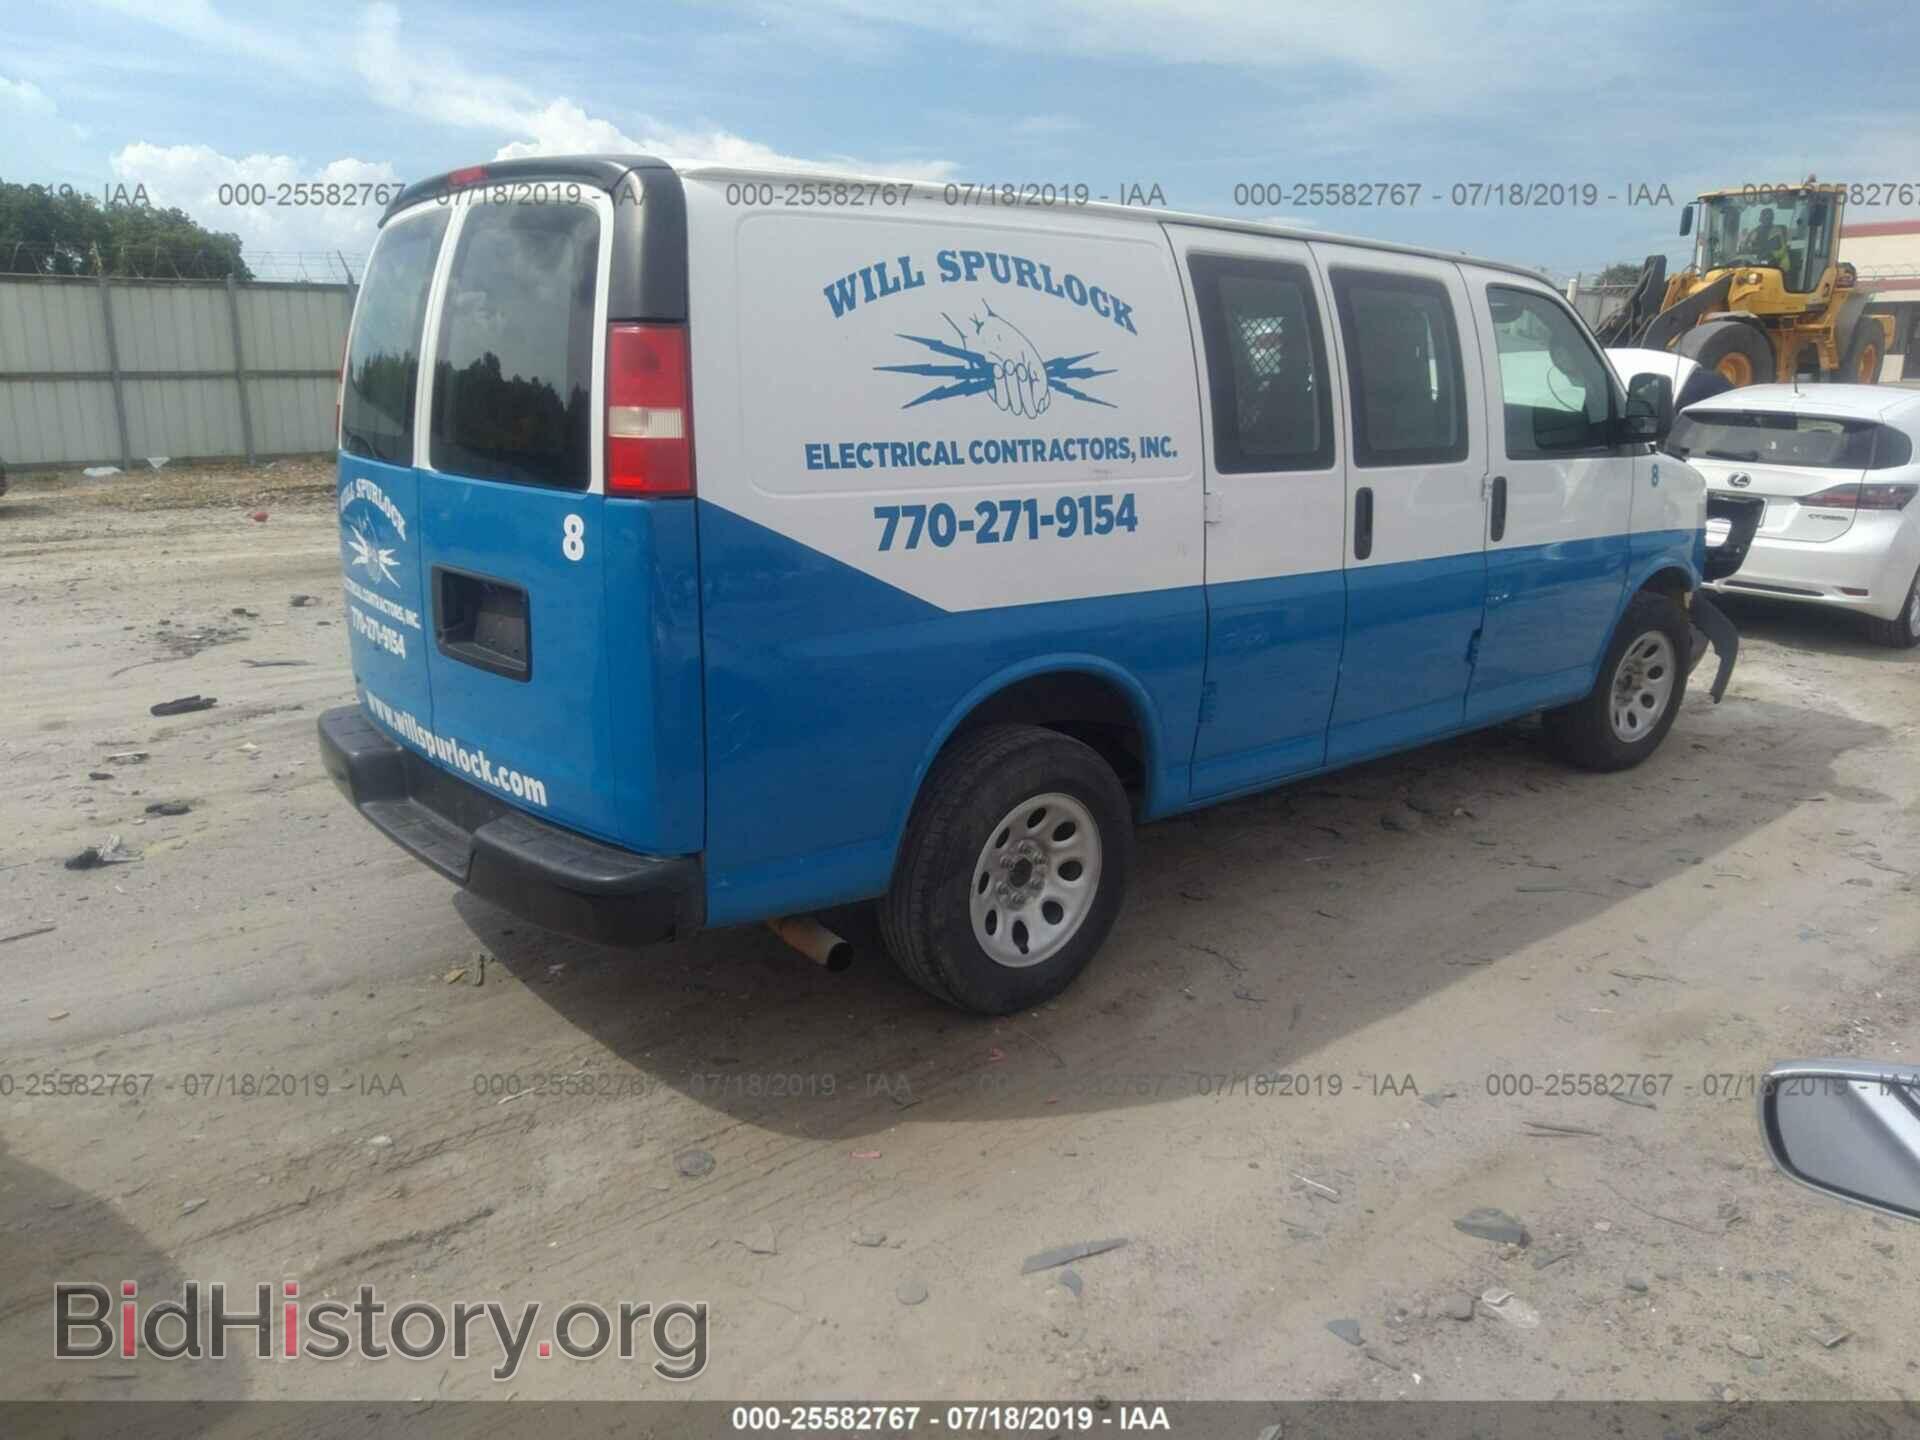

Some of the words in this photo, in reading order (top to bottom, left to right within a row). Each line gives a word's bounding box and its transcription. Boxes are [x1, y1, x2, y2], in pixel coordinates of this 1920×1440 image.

[823, 255, 926, 318] WILL
[936, 249, 1139, 336] SPURLOCK
[804, 440, 965, 471] ELECTRICAL
[968, 436, 1137, 466] CONTRACTORS,
[1140, 435, 1178, 459] INC.
[562, 513, 585, 562] 8
[872, 493, 1139, 552] 770-271-9154
[366, 689, 548, 808] www.willspurlock.com
